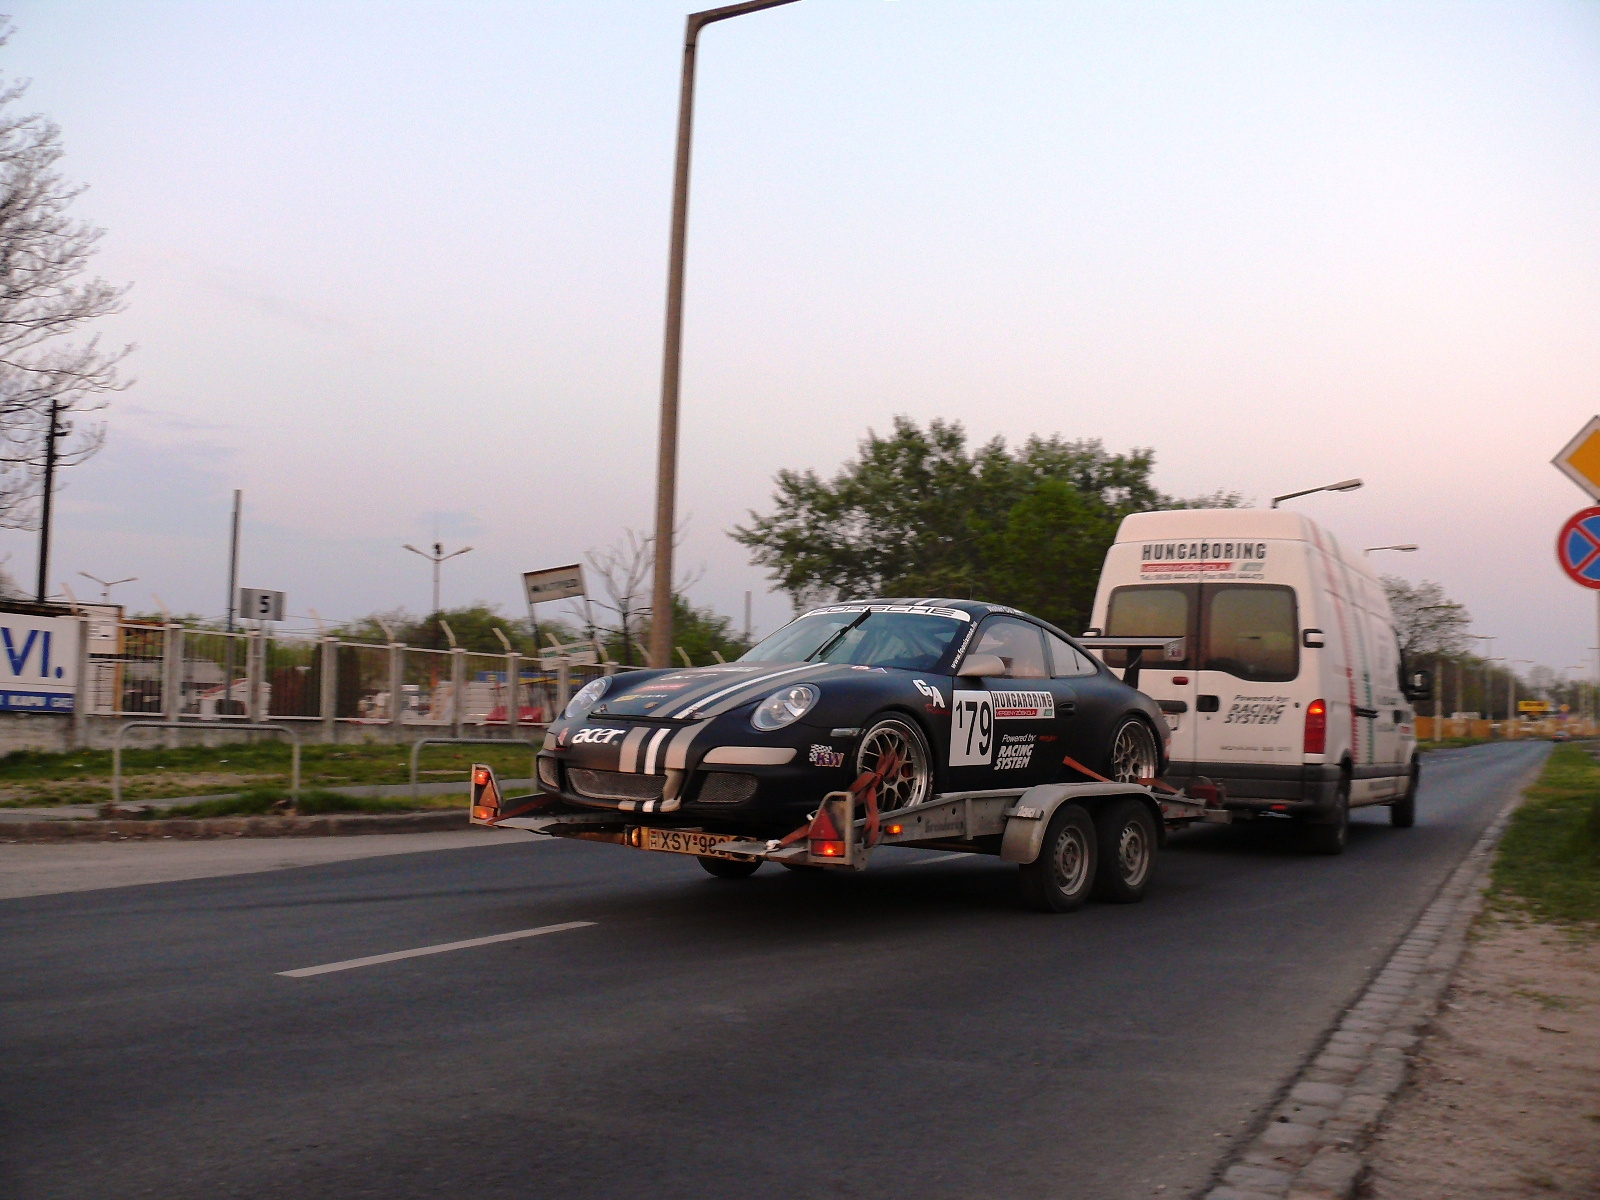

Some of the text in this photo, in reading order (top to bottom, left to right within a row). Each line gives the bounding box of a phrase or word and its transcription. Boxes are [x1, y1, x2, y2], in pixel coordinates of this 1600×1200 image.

[1142, 543, 1266, 560] HUNGARORING
[260, 595, 269, 613] 5
[993, 693, 1053, 708] HUNGARORING
[1229, 704, 1286, 714] RACING
[1223, 714, 1281, 724] SYSTEM
[956, 700, 991, 756] 179
[572, 728, 626, 744] acer
[1002, 734, 1027, 742] Powered
[998, 744, 1035, 758] RACING
[815, 752, 845, 768] KW
[994, 756, 1031, 770] SYSTEM
